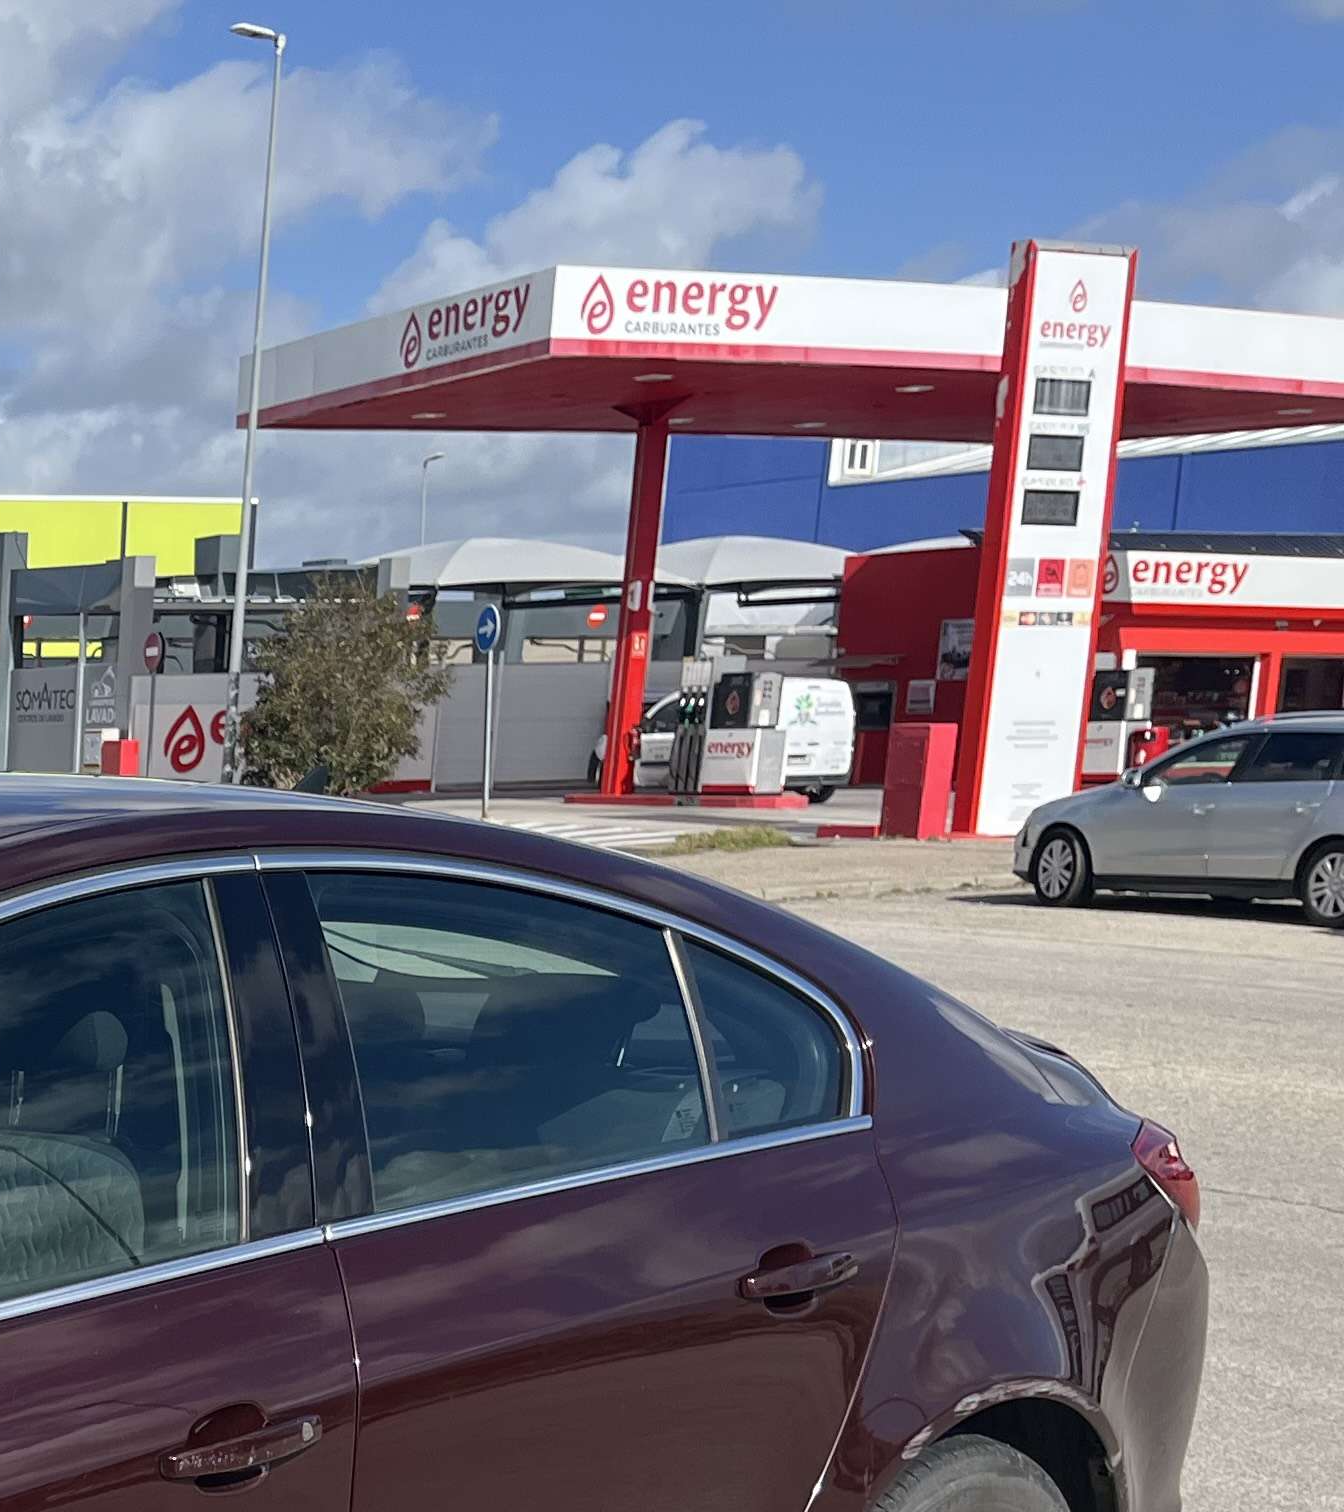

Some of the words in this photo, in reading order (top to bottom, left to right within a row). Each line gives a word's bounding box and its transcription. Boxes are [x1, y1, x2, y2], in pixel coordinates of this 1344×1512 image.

[427, 282, 531, 340] energy
[625, 278, 780, 332] energy
[624, 319, 721, 337] CARBURANTES
[1040, 319, 1112, 349] energy
[425, 335, 489, 362] CARBURANTES
[1008, 570, 1033, 587] 24h
[1132, 558, 1250, 595] energy
[706, 740, 754, 759] energy
